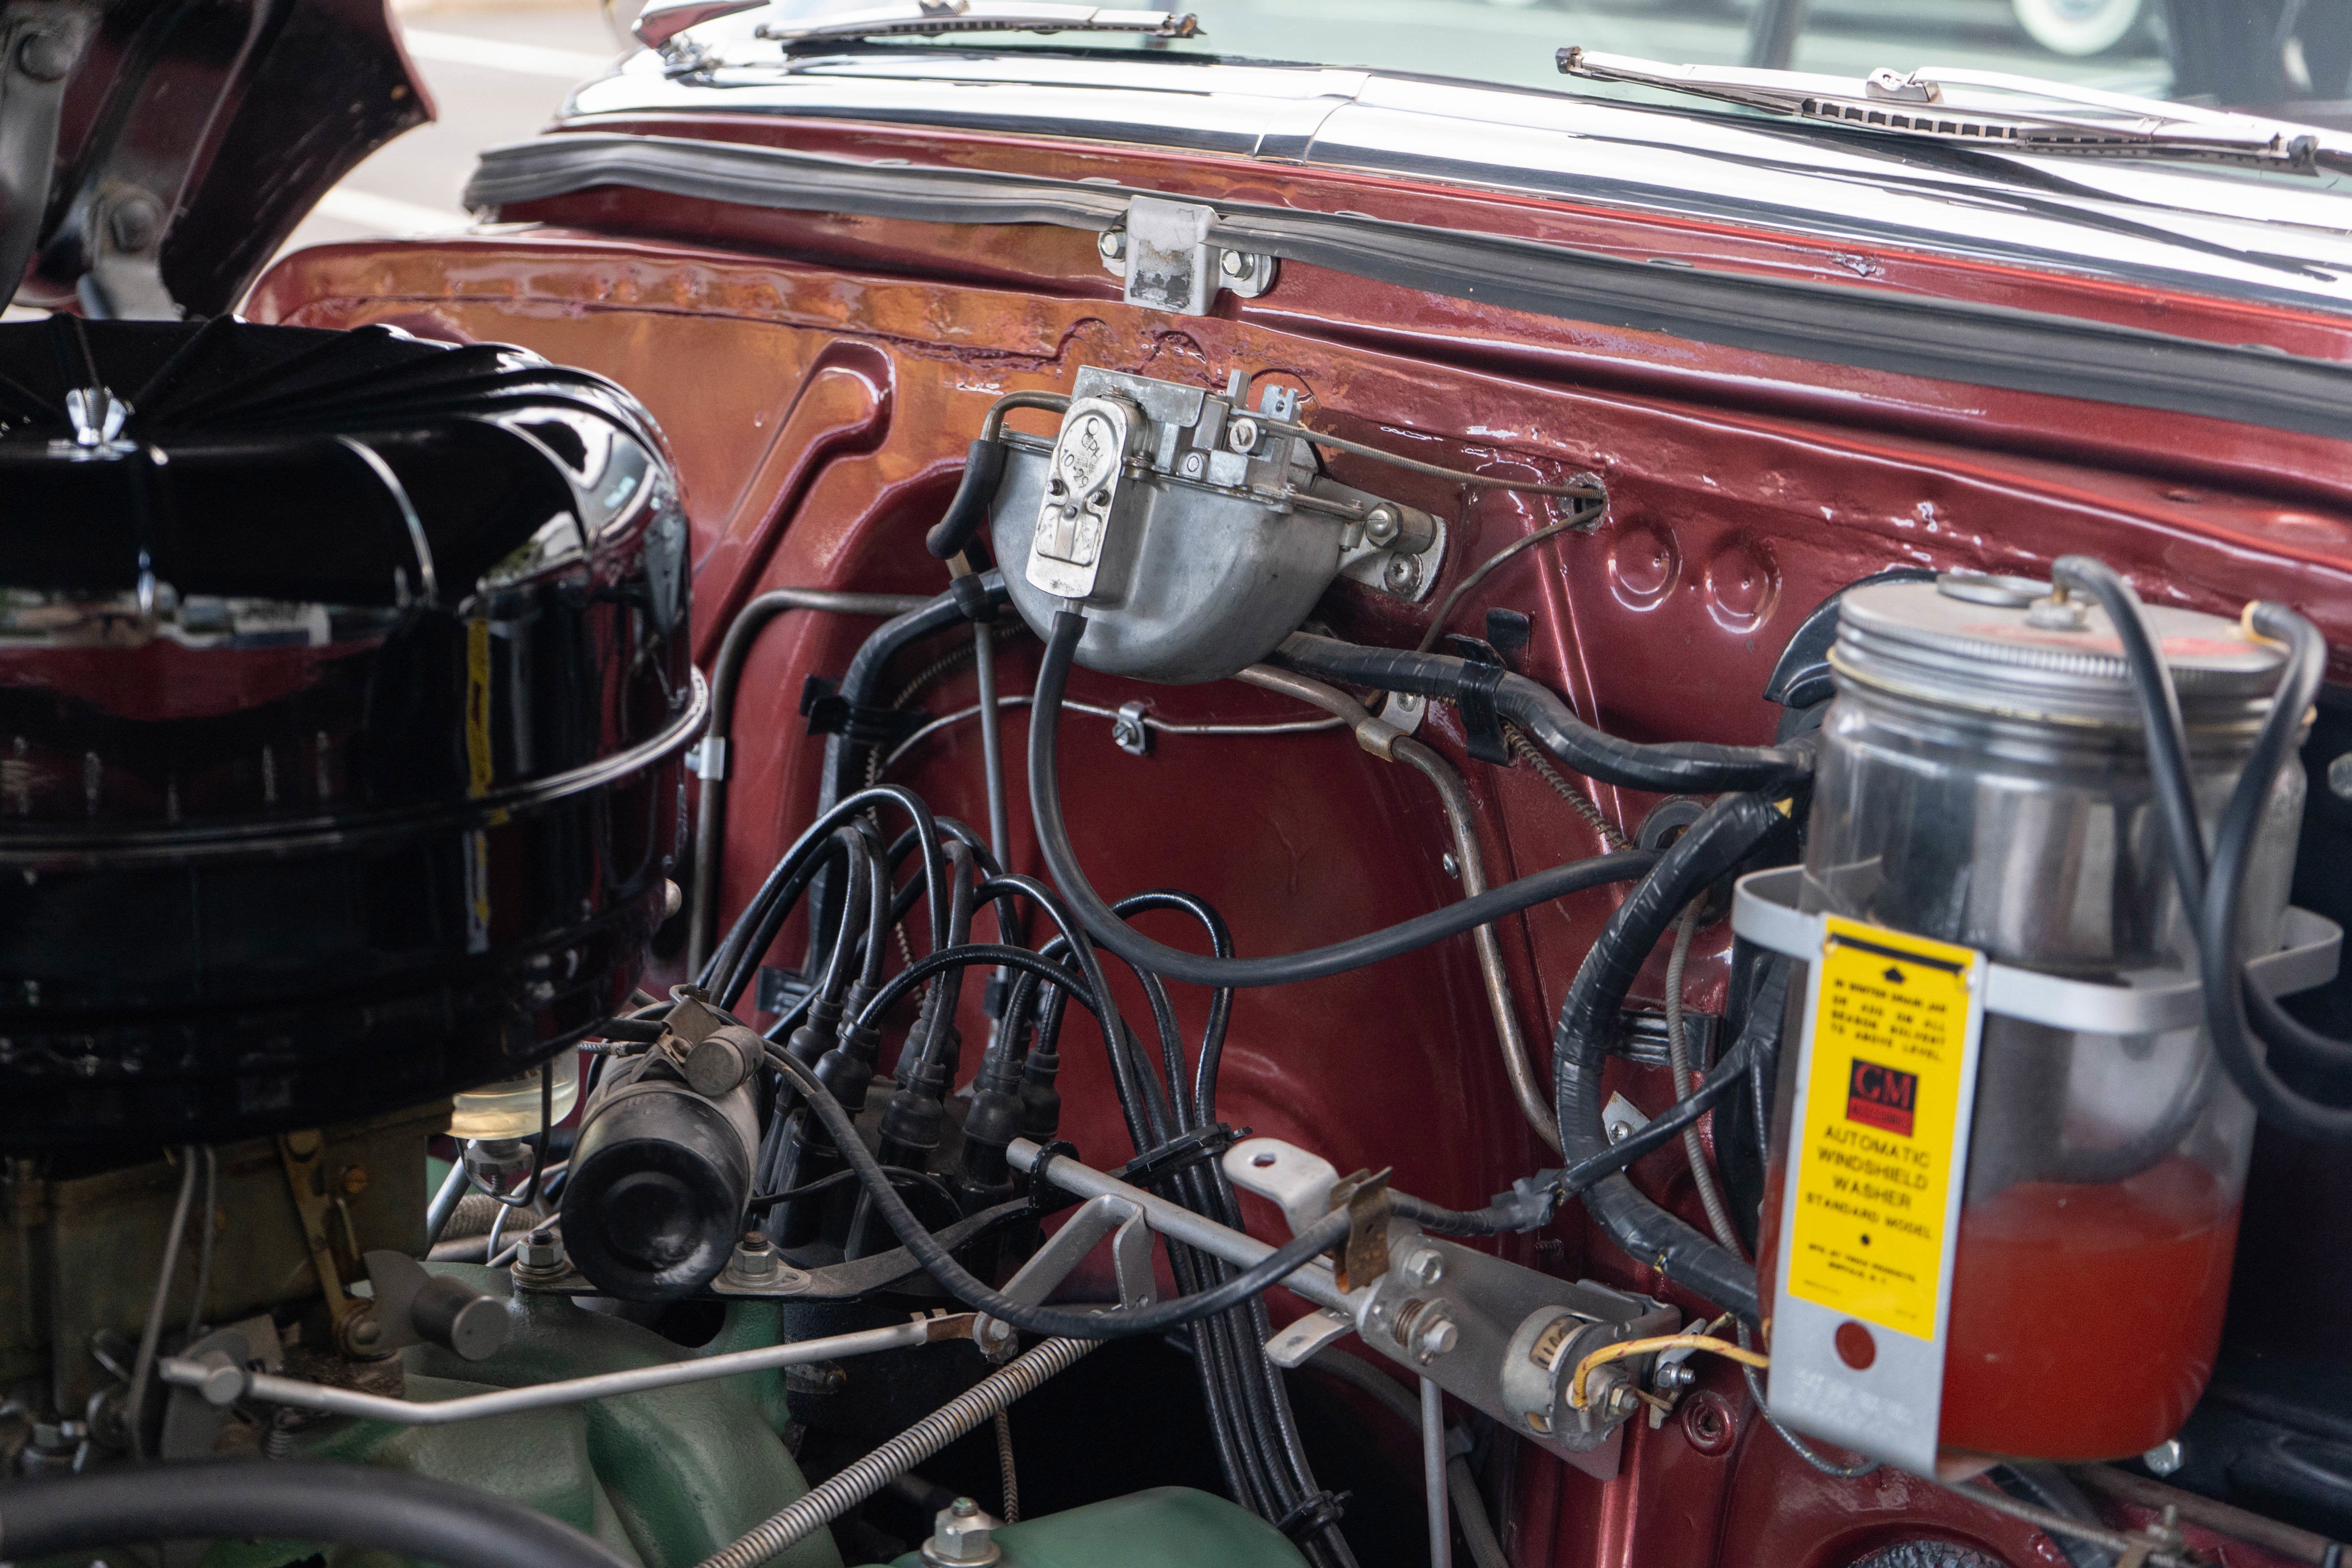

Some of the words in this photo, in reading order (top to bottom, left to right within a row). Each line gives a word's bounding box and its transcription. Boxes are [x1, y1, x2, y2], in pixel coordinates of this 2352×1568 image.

[1818, 1147, 1928, 1190] WINDSHIELD
[1825, 1125, 1930, 1169] AUTOMATIC
[1833, 1175, 1912, 1210] WASHER
[1806, 1192, 1879, 1223] STANDARD
[1885, 1216, 1931, 1239] MODEL
